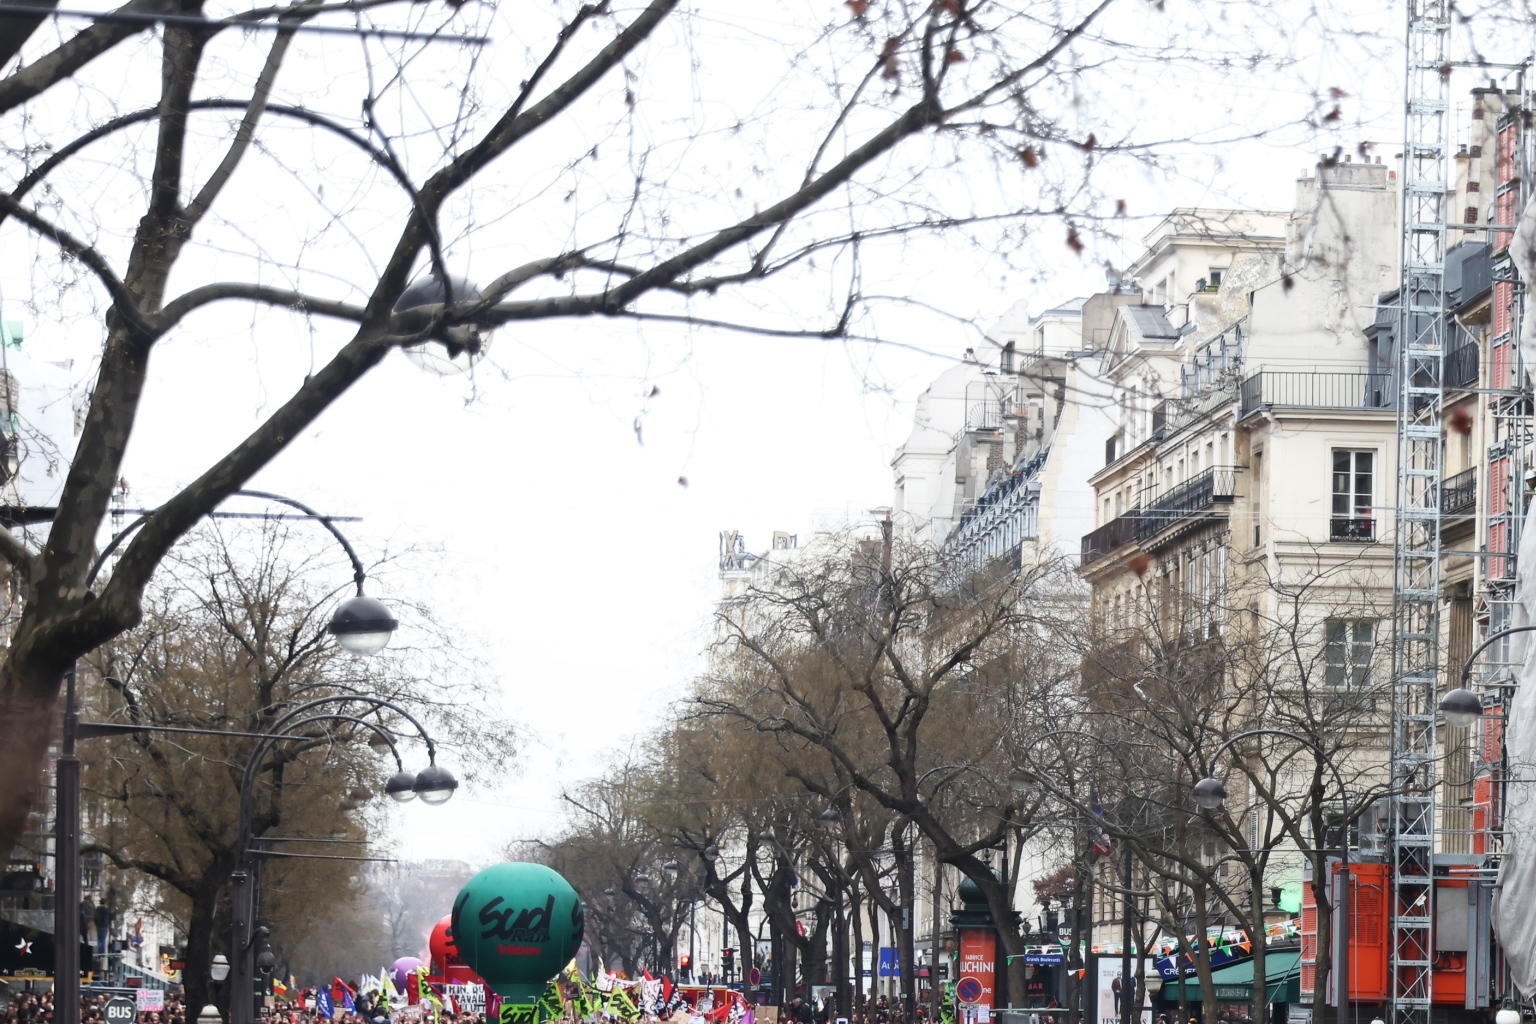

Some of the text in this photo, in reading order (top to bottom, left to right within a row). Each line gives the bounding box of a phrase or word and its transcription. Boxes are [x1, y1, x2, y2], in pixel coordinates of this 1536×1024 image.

[479, 894, 556, 940] Sud
[1058, 927, 1072, 936] BUS
[107, 1005, 133, 1020] BUS
